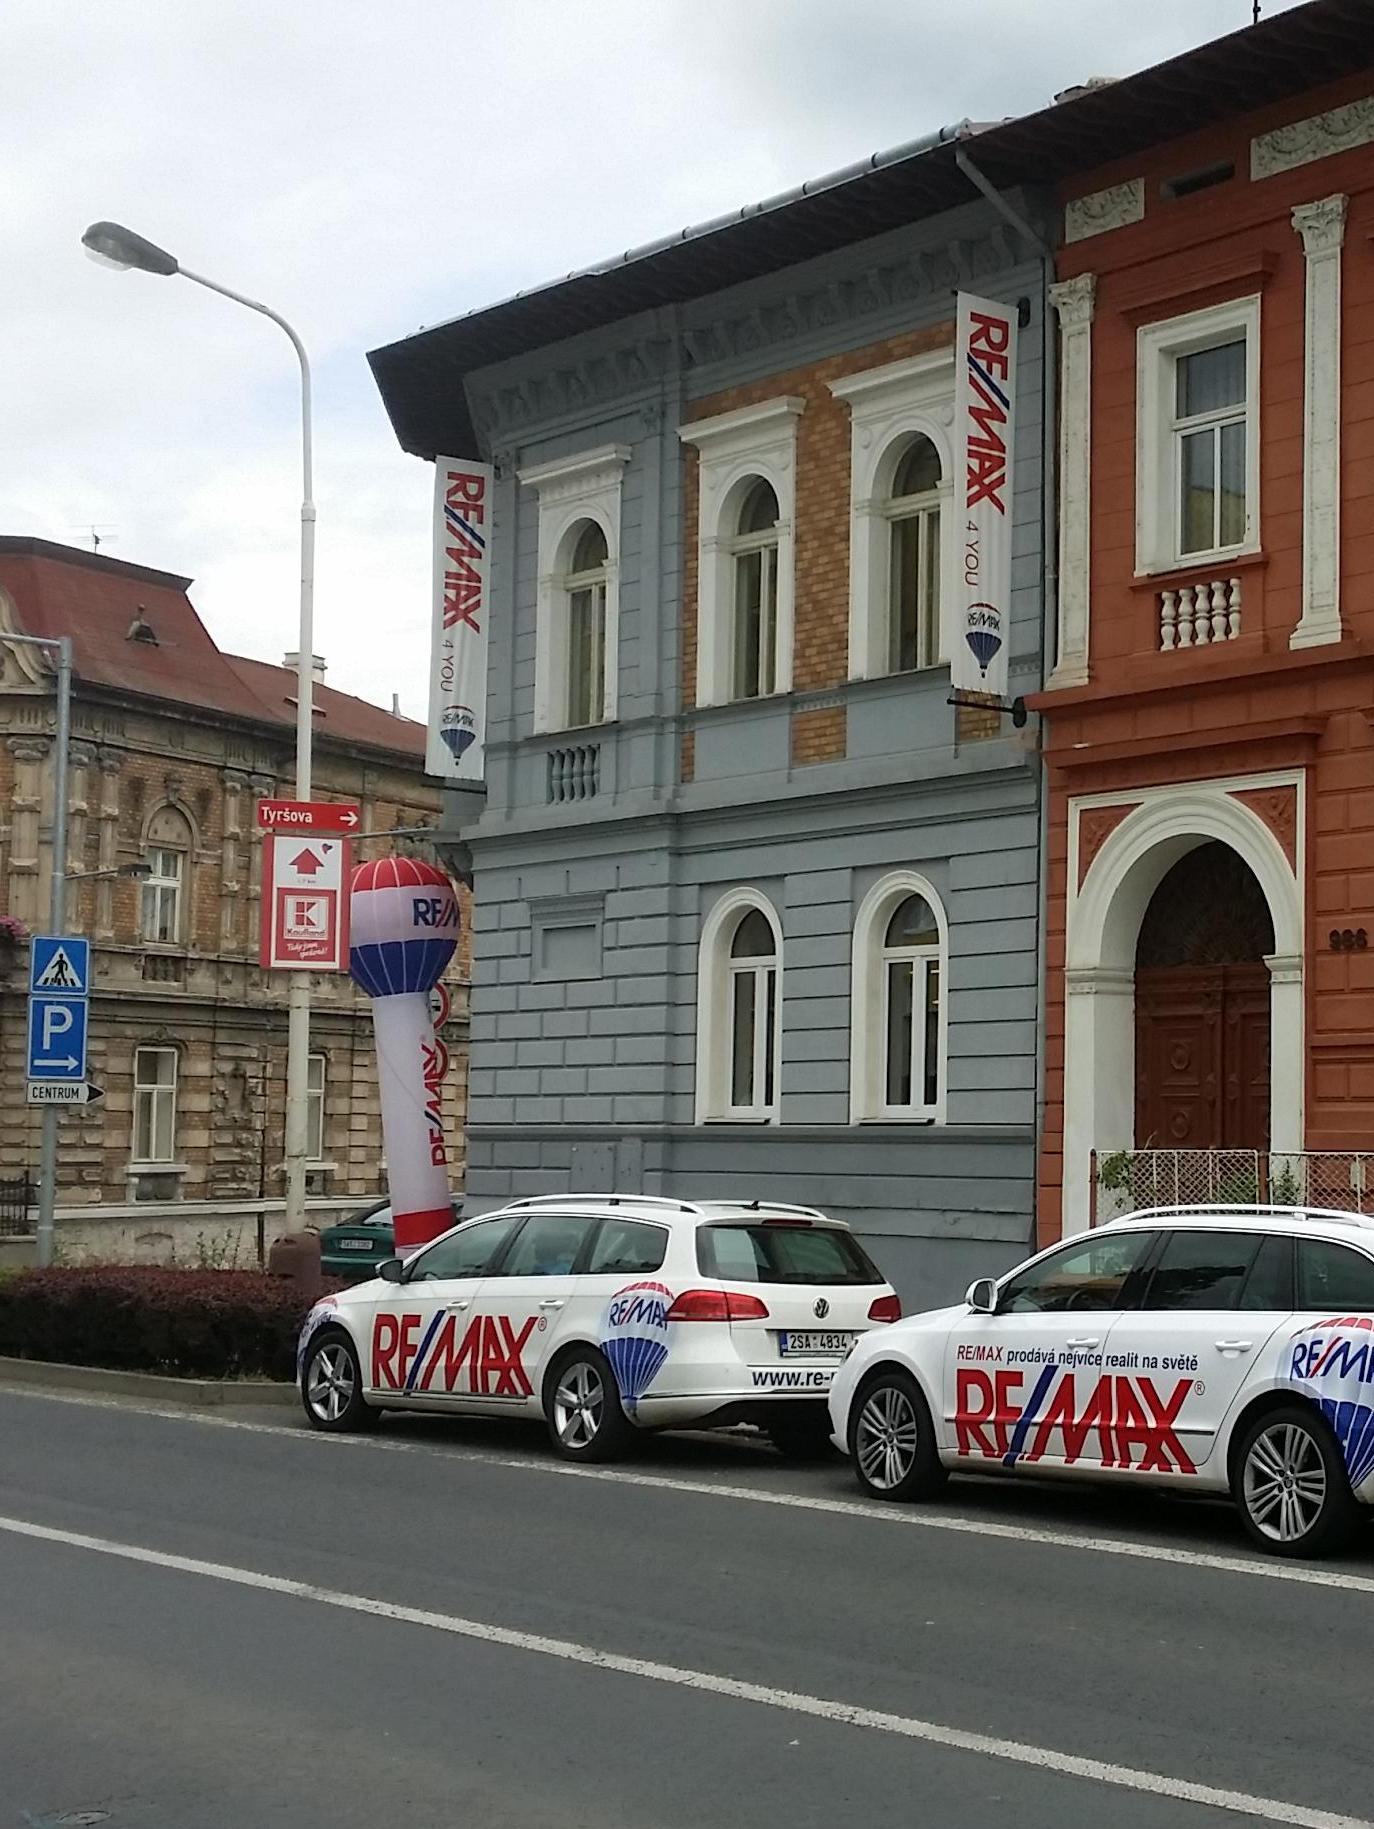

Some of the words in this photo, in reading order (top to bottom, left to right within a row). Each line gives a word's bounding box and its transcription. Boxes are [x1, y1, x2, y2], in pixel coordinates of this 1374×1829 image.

[967, 311, 1010, 516] RE/MAX
[966, 520, 979, 532] 4
[443, 471, 486, 634] RE/MAX
[964, 540, 979, 586] YOU
[967, 611, 1001, 632] RE/MAX
[440, 655, 454, 692] YOU
[261, 806, 313, 824] Tyršova
[413, 898, 460, 928] RE/M
[42, 1005, 73, 1050] P
[32, 1086, 80, 1099] CENTRUM
[820, 1335, 847, 1349] 4834
[957, 1345, 1004, 1361] RE/MAX
[1006, 1348, 1055, 1365] prodává
[1105, 1352, 1139, 1368] realit
[1142, 1356, 1158, 1369] na
[1161, 1354, 1198, 1371] světě
